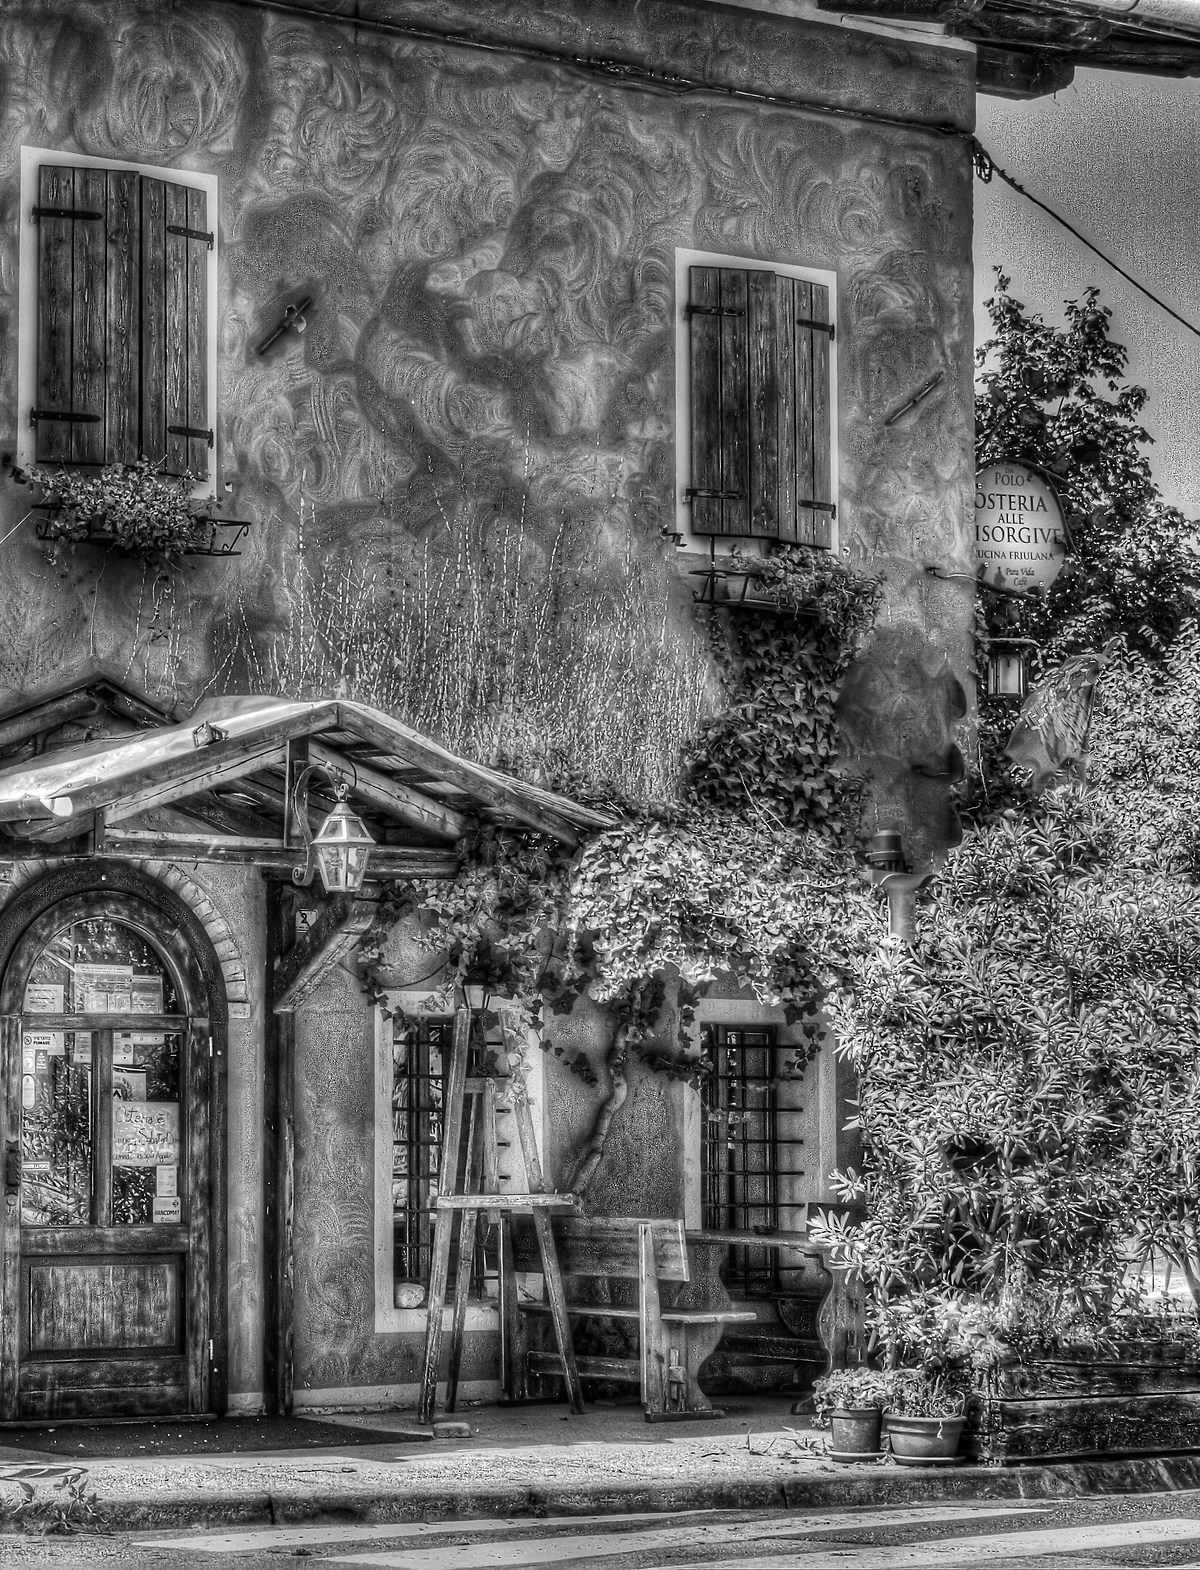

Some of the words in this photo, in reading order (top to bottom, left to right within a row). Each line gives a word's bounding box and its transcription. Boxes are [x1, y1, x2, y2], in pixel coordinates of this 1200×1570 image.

[995, 472, 1025, 487] POLO
[974, 492, 1048, 512] OSTERIA
[997, 513, 1025, 525] ALLE
[975, 524, 1062, 545] ISORGIVE
[1009, 551, 1055, 561] FRIULANA
[1020, 567, 1035, 577] Vida
